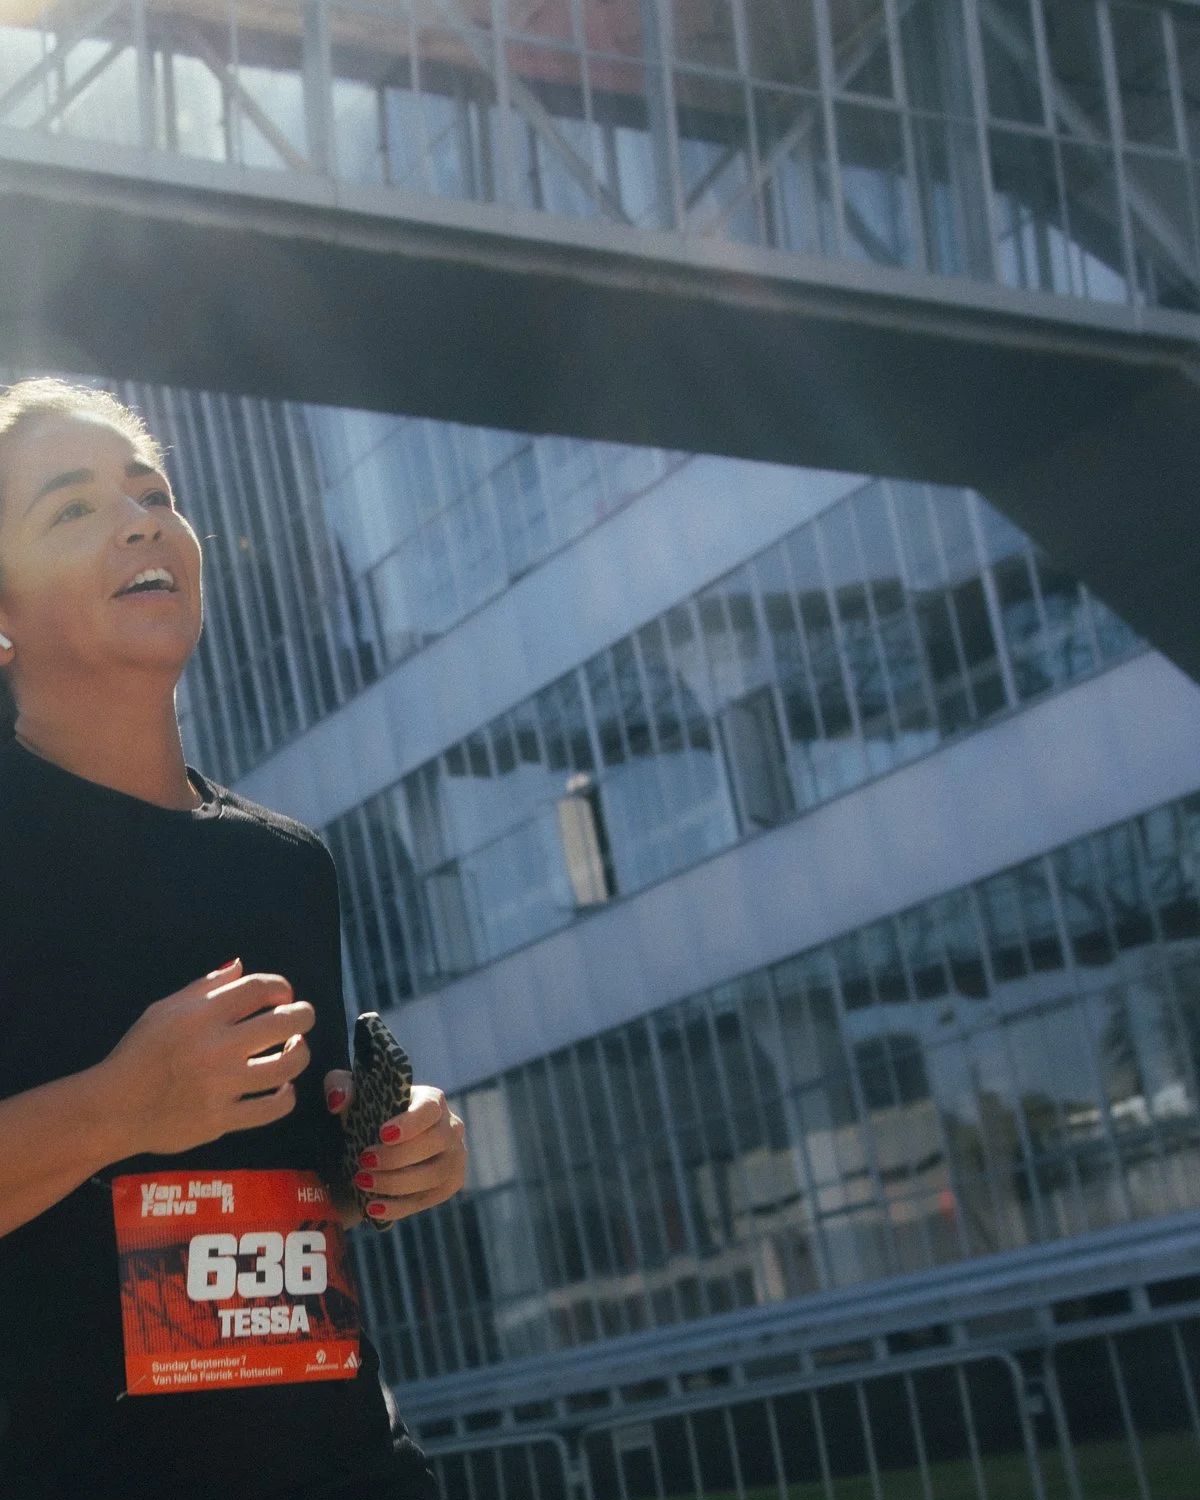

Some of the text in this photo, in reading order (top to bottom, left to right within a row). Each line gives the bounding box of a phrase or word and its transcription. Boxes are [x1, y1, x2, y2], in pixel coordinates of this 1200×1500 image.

[141, 1179, 234, 1201] Van Nelle
[187, 1231, 328, 1301] 636
[218, 1305, 310, 1338] TESSA
[152, 1360, 189, 1374] Sunday
[190, 1356, 241, 1372] September
[152, 1374, 171, 1386] Van
[173, 1371, 198, 1385] Nelle
[199, 1369, 234, 1382] Fabriek
[240, 1366, 283, 1379] Rotterdam
